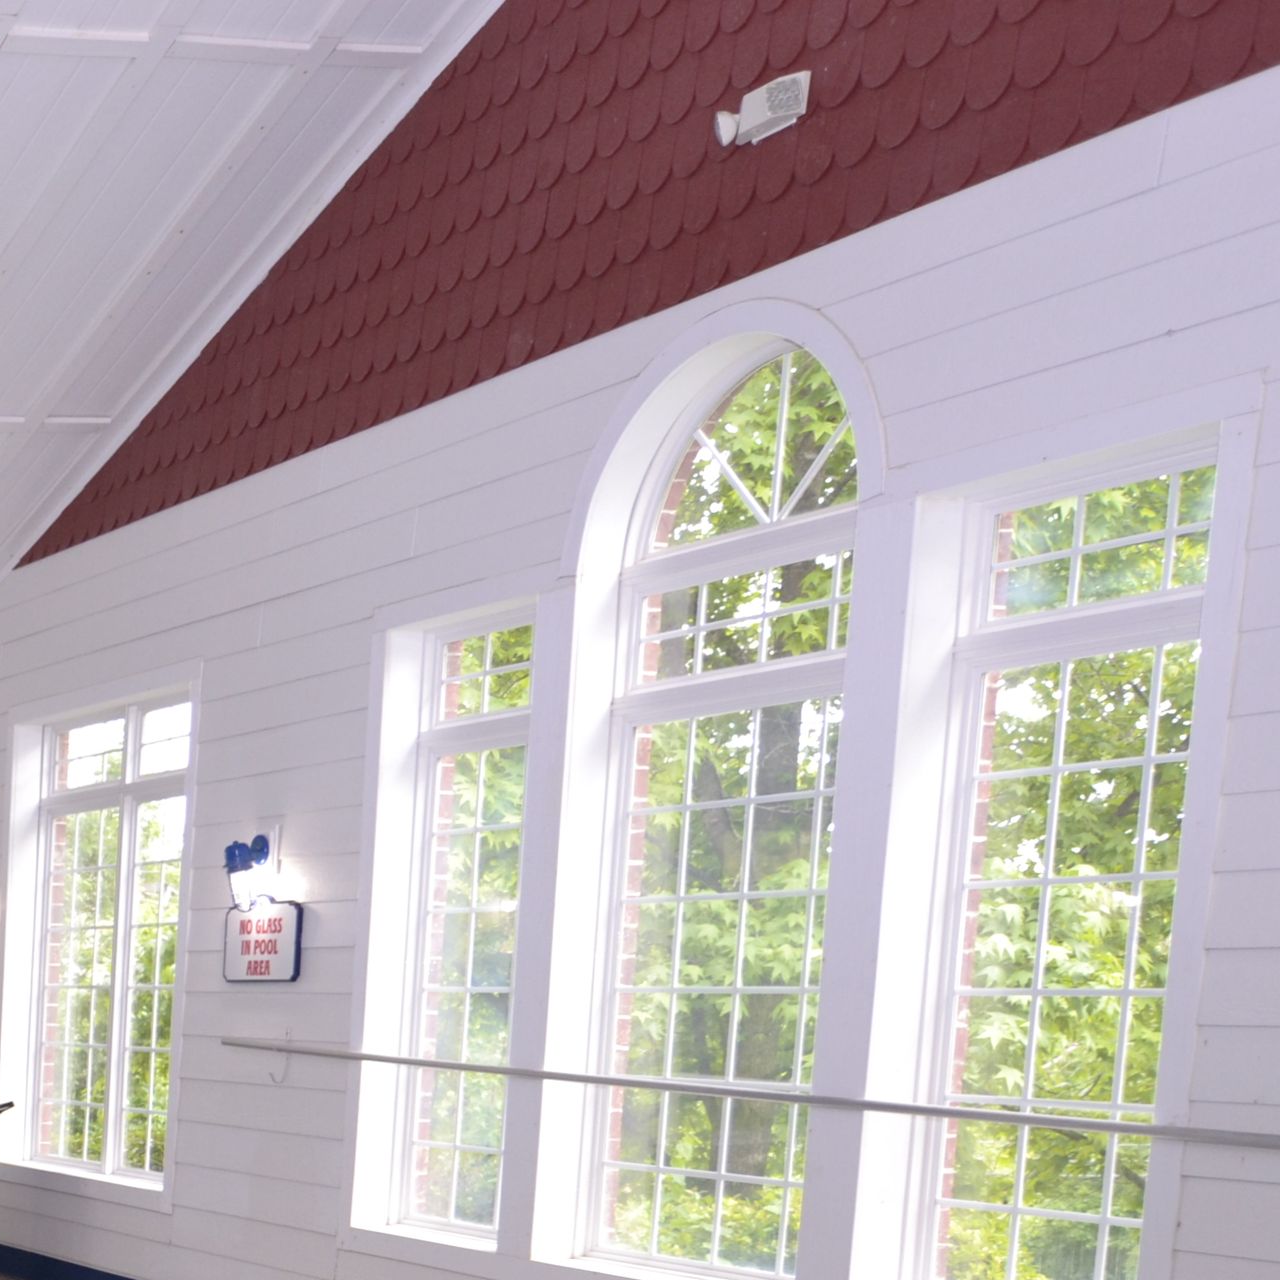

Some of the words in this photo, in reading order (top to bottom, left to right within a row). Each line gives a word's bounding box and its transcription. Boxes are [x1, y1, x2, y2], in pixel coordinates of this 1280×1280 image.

[239, 919, 252, 935] NO
[256, 918, 283, 934] GLASS
[241, 940, 251, 955] IN
[254, 939, 278, 955] POOL
[246, 960, 271, 976] AREA
